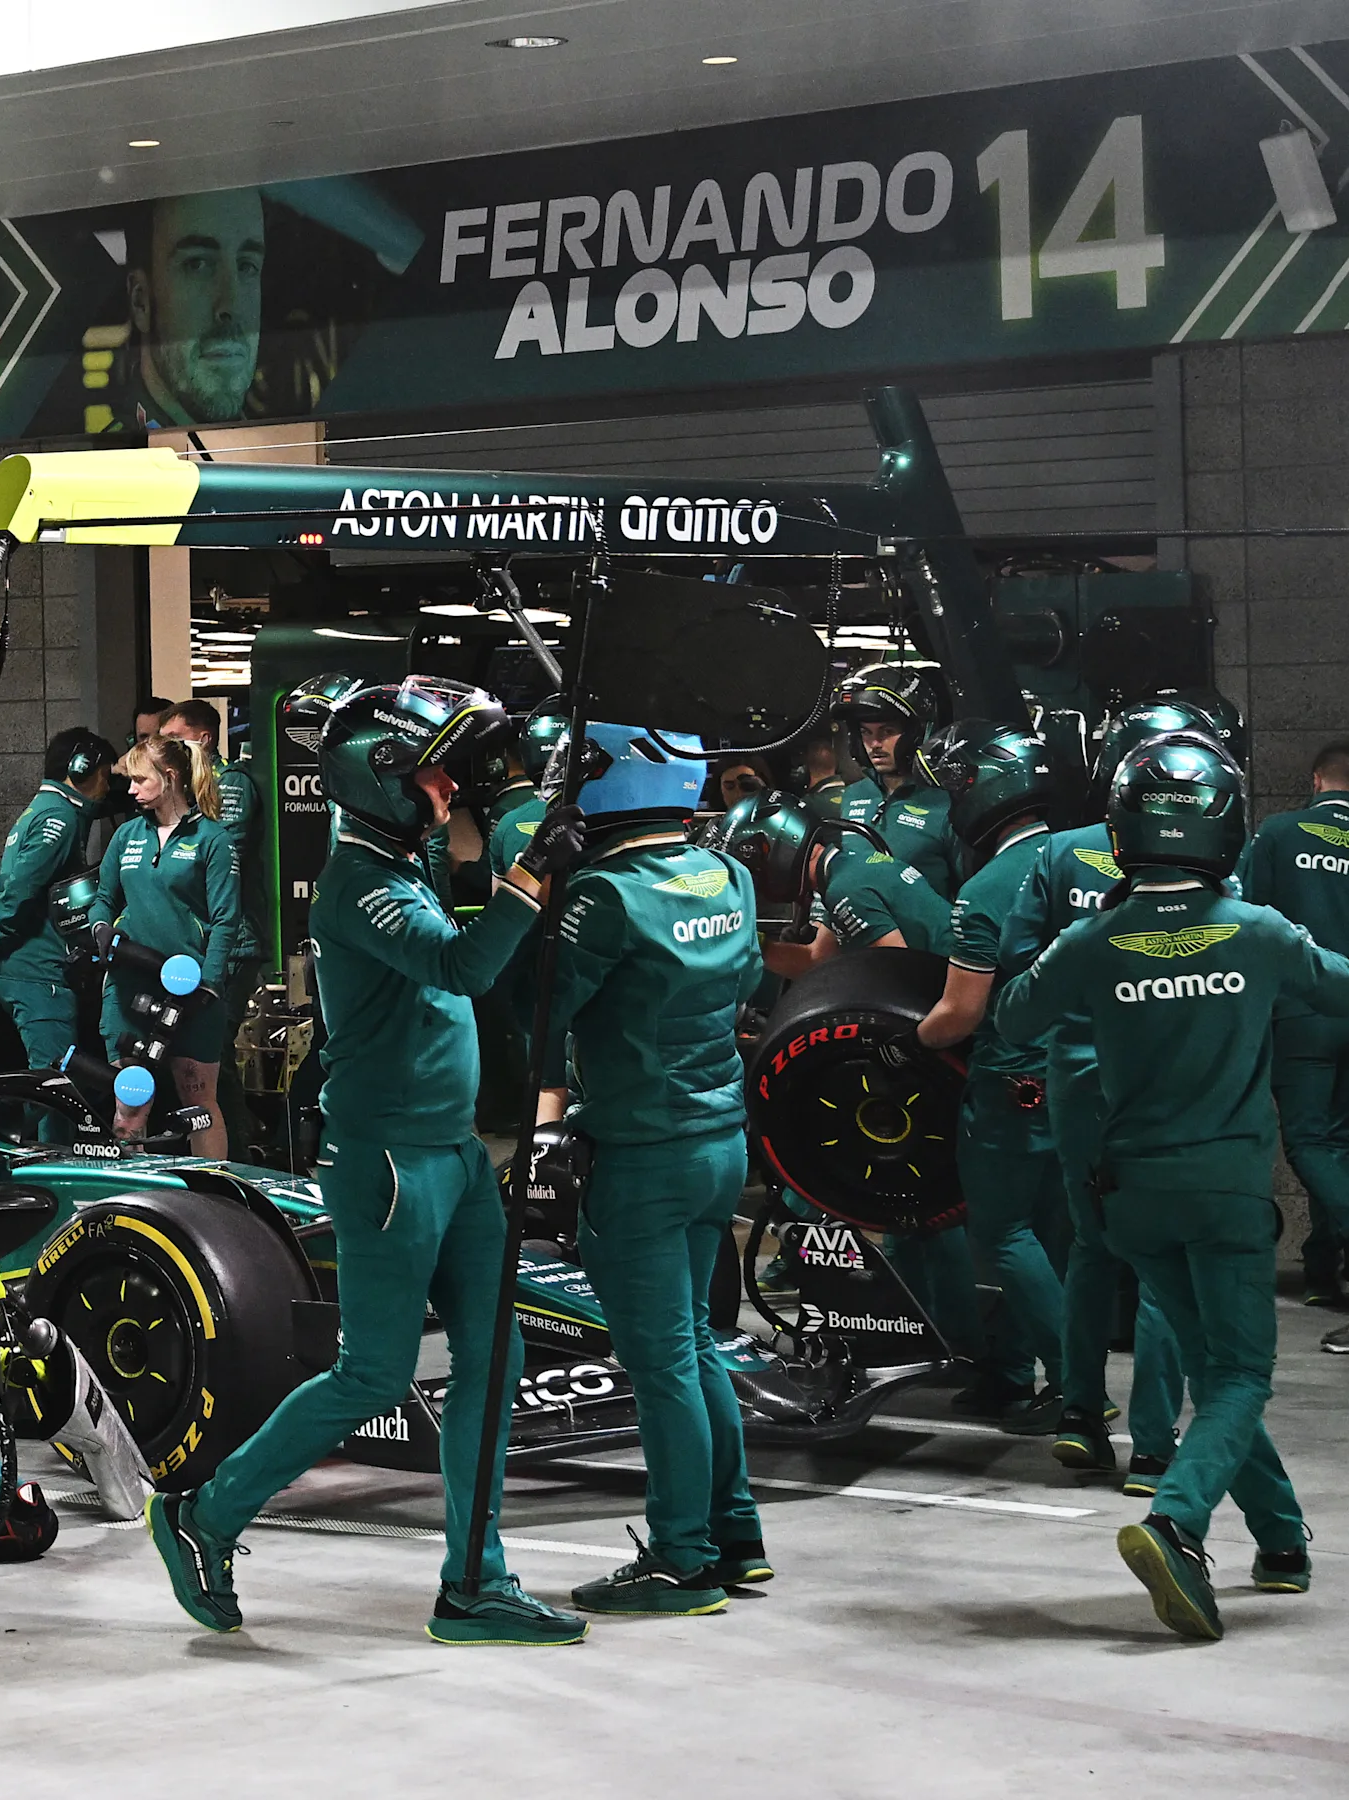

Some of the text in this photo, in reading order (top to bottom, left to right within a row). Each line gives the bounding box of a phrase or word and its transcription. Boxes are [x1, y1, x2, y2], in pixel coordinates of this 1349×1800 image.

[440, 150, 953, 284] FERNANDO
[976, 115, 1165, 321] 14
[494, 245, 875, 359] ALONSO
[331, 487, 779, 545] ASTON MARTIN aramco
[373, 708, 432, 738] Valvoline
[430, 714, 475, 764] ASTON MARTIN
[284, 801, 327, 813] FORMULA
[1142, 791, 1206, 806] cognizant
[897, 813, 925, 827] aramco
[1159, 828, 1184, 839] Stilo
[1295, 852, 1349, 876] aram
[1157, 903, 1188, 913] BOSS
[673, 909, 743, 943] aramco
[1145, 931, 1204, 945] ASTON MARTIN
[1115, 971, 1246, 1003] aramco
[759, 1023, 859, 1100] P ZERO
[78, 1123, 101, 1133] NexGen
[191, 1113, 211, 1132] BOSS
[73, 1142, 121, 1158] aramco
[38, 1218, 86, 1275] PIRELLI
[801, 1226, 862, 1254] AVA
[800, 1249, 865, 1271] TRADE
[516, 1311, 584, 1339] PERREGAUX
[828, 1310, 926, 1336] Bombardier
[150, 1386, 215, 1481] P ZER
